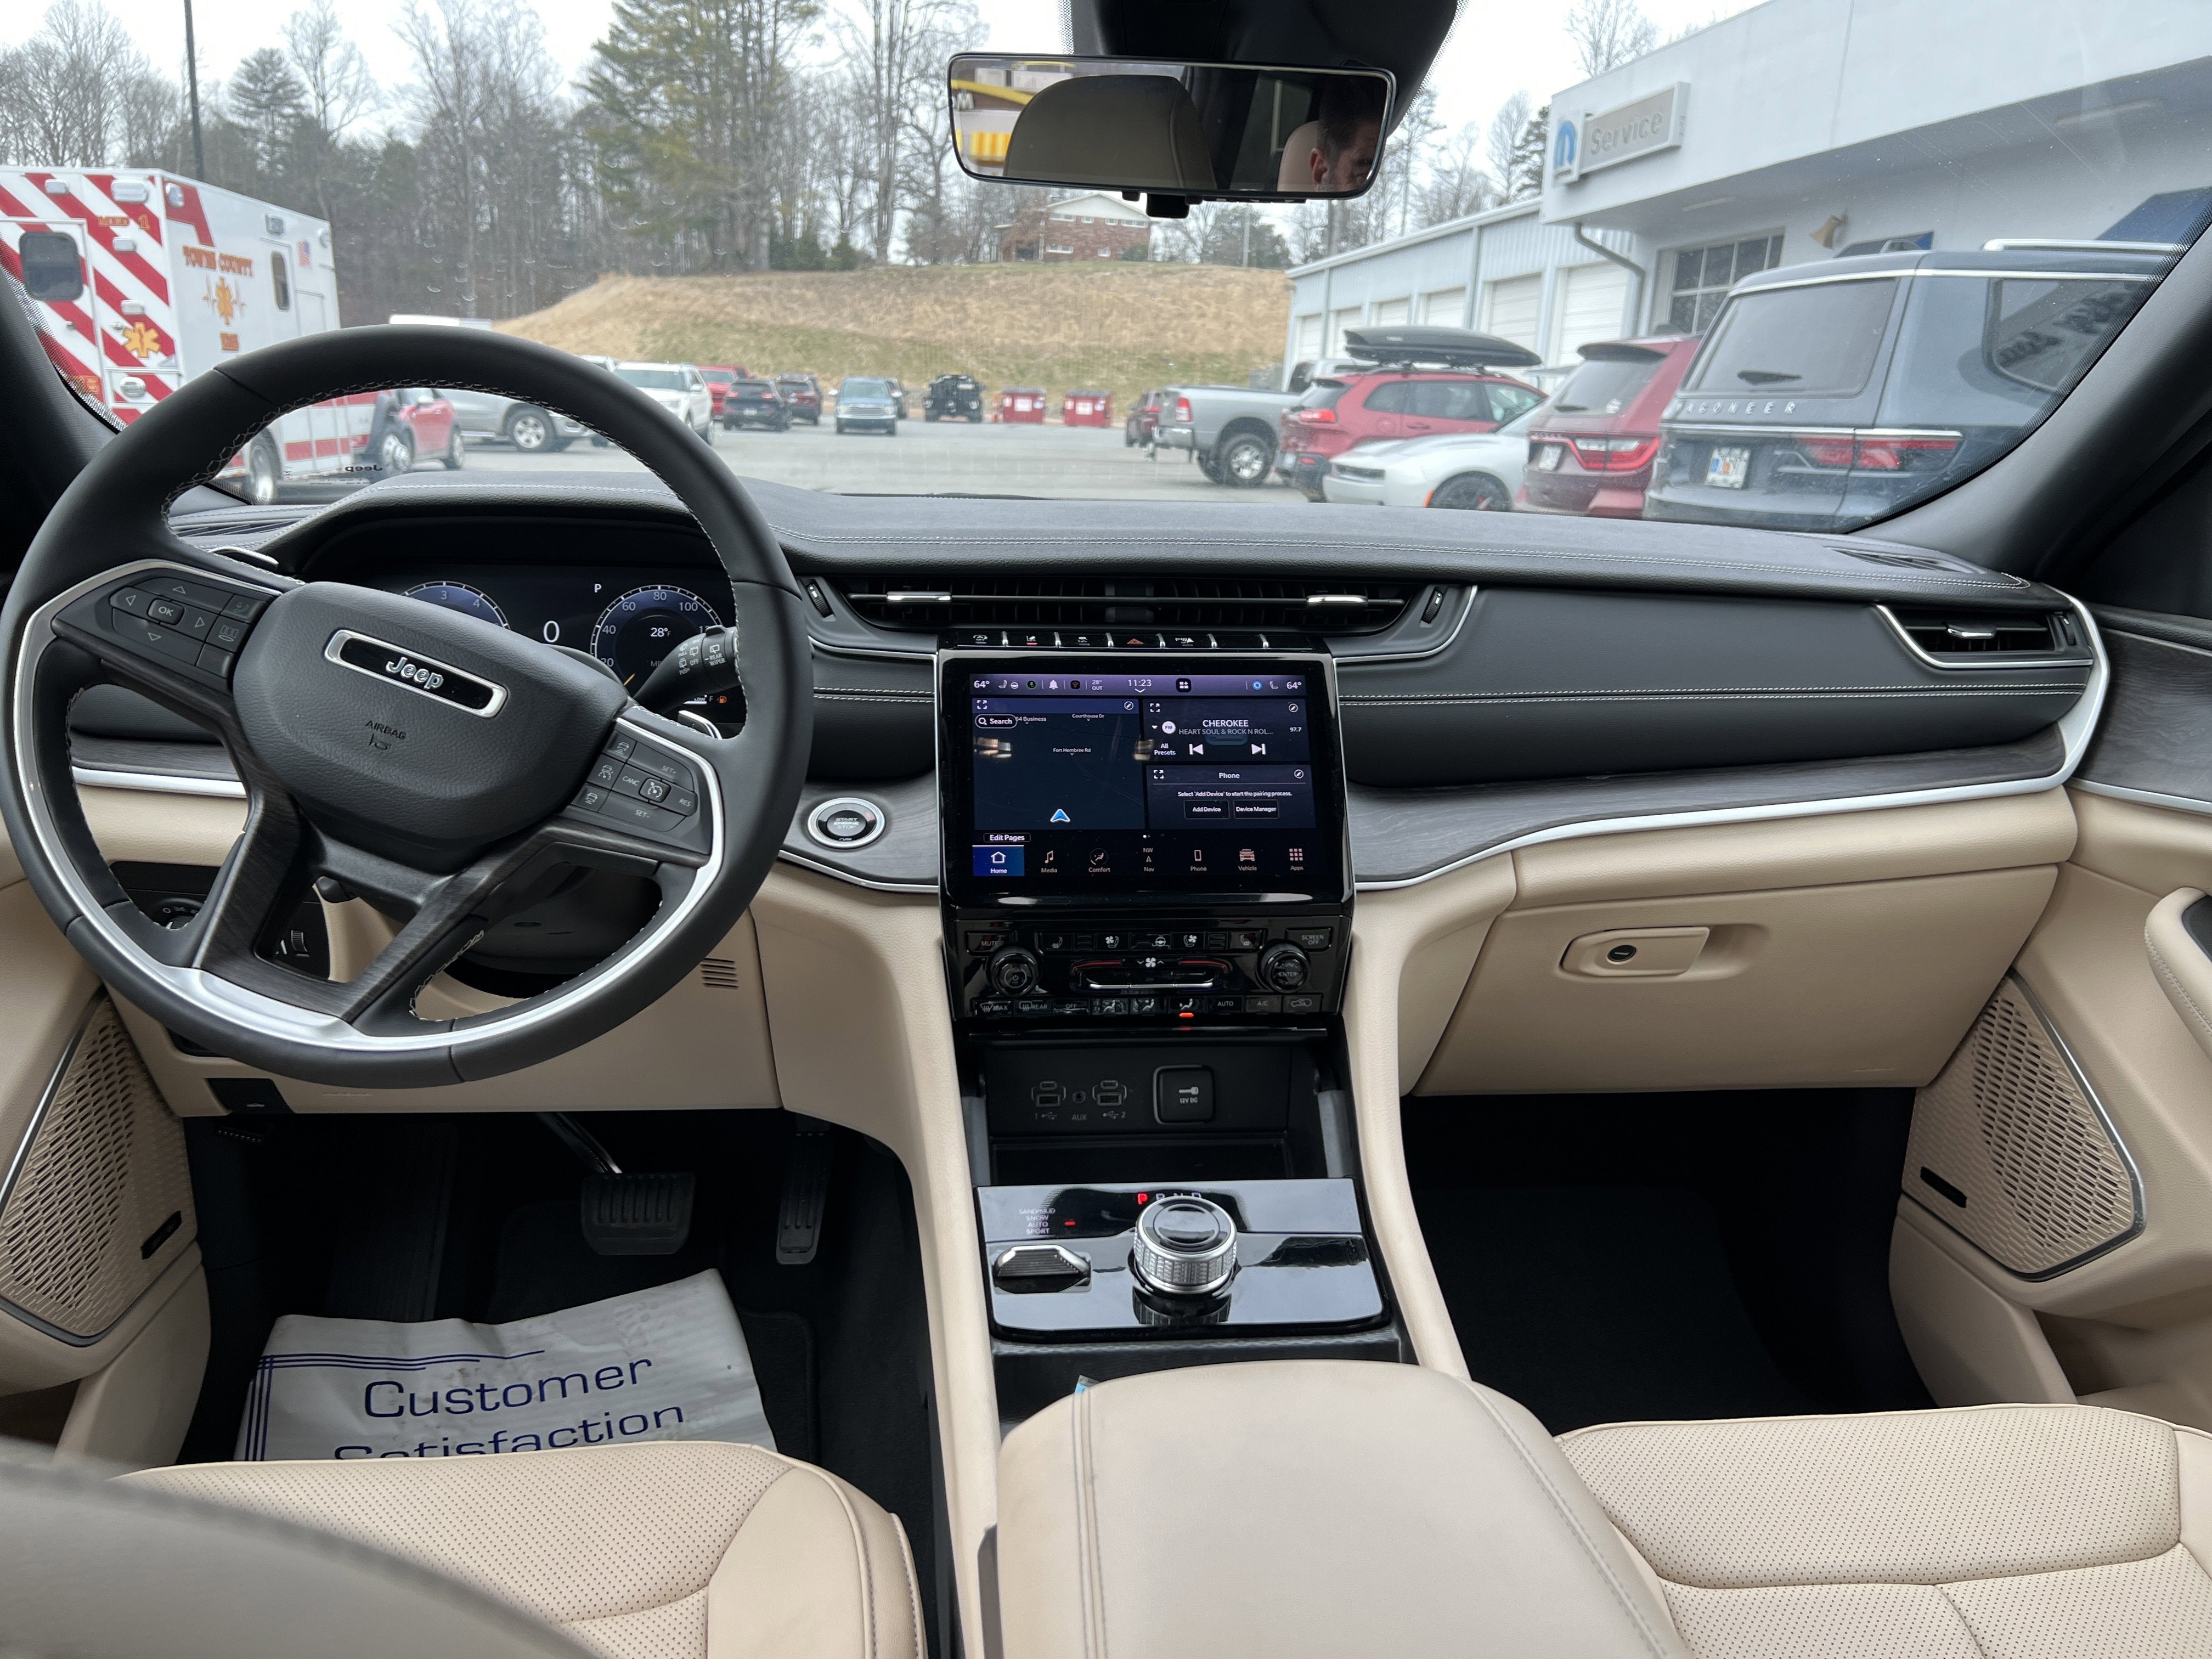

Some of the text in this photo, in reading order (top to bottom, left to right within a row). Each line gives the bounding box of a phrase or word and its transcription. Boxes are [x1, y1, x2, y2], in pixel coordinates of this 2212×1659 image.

[1592, 112, 1663, 155] Service
[594, 584, 602, 593] P
[441, 590, 447, 600] 3
[653, 592, 667, 601] 80
[473, 599, 480, 608] 4
[622, 602, 636, 611] 60
[679, 602, 698, 612] 100
[159, 606, 173, 617] OK
[543, 620, 560, 642] 0
[602, 625, 616, 634] 40
[709, 658, 726, 666] WIPER
[385, 657, 444, 689] Jeep
[973, 680, 990, 688] 64°
[1286, 681, 1302, 689] 64°
[1202, 719, 1249, 727] CHEROKEE
[365, 720, 407, 740] AIRBAG
[622, 776, 640, 786] CANC
[679, 798, 692, 808] RES
[1137, 1193, 1148, 1205] P
[365, 1358, 653, 1418] Customer
